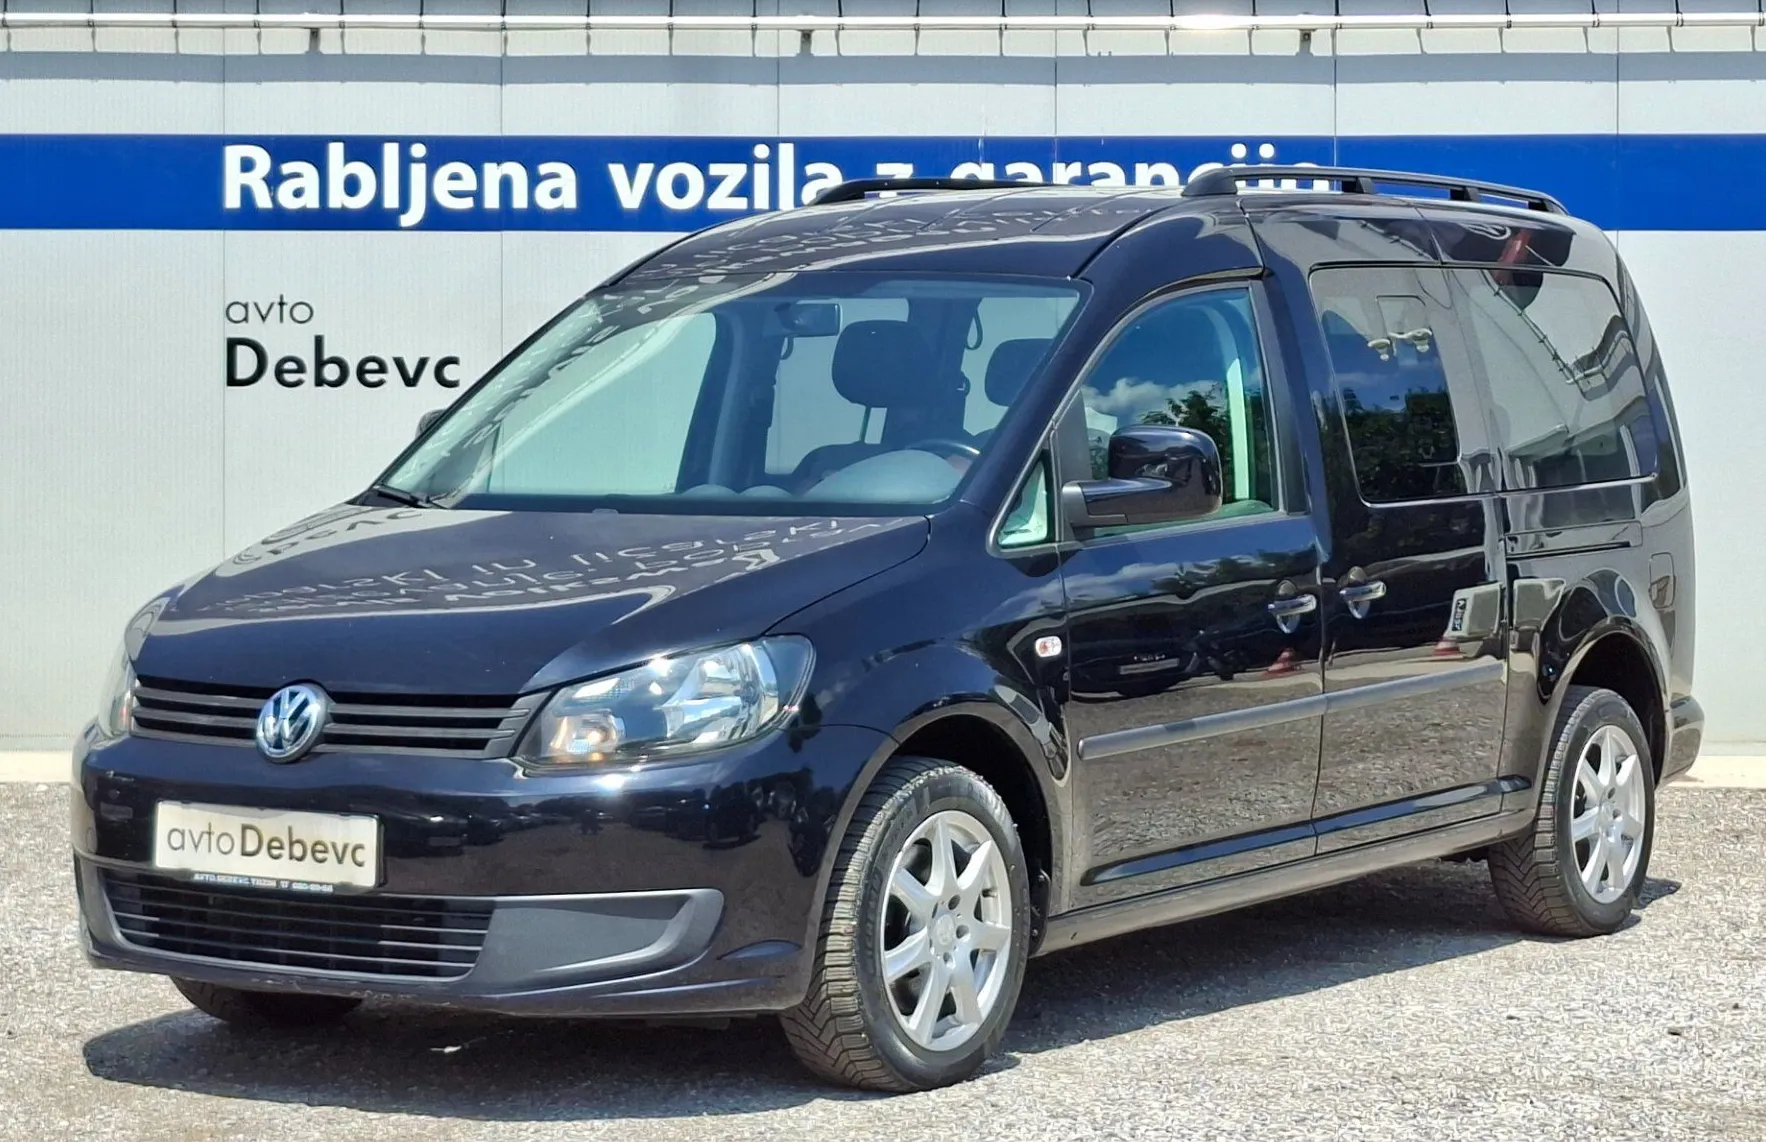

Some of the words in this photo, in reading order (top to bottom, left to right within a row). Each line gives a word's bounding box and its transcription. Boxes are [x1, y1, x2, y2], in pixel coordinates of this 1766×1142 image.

[223, 142, 578, 228] Rabljena
[225, 294, 315, 325] avto
[225, 336, 461, 389] Debevc
